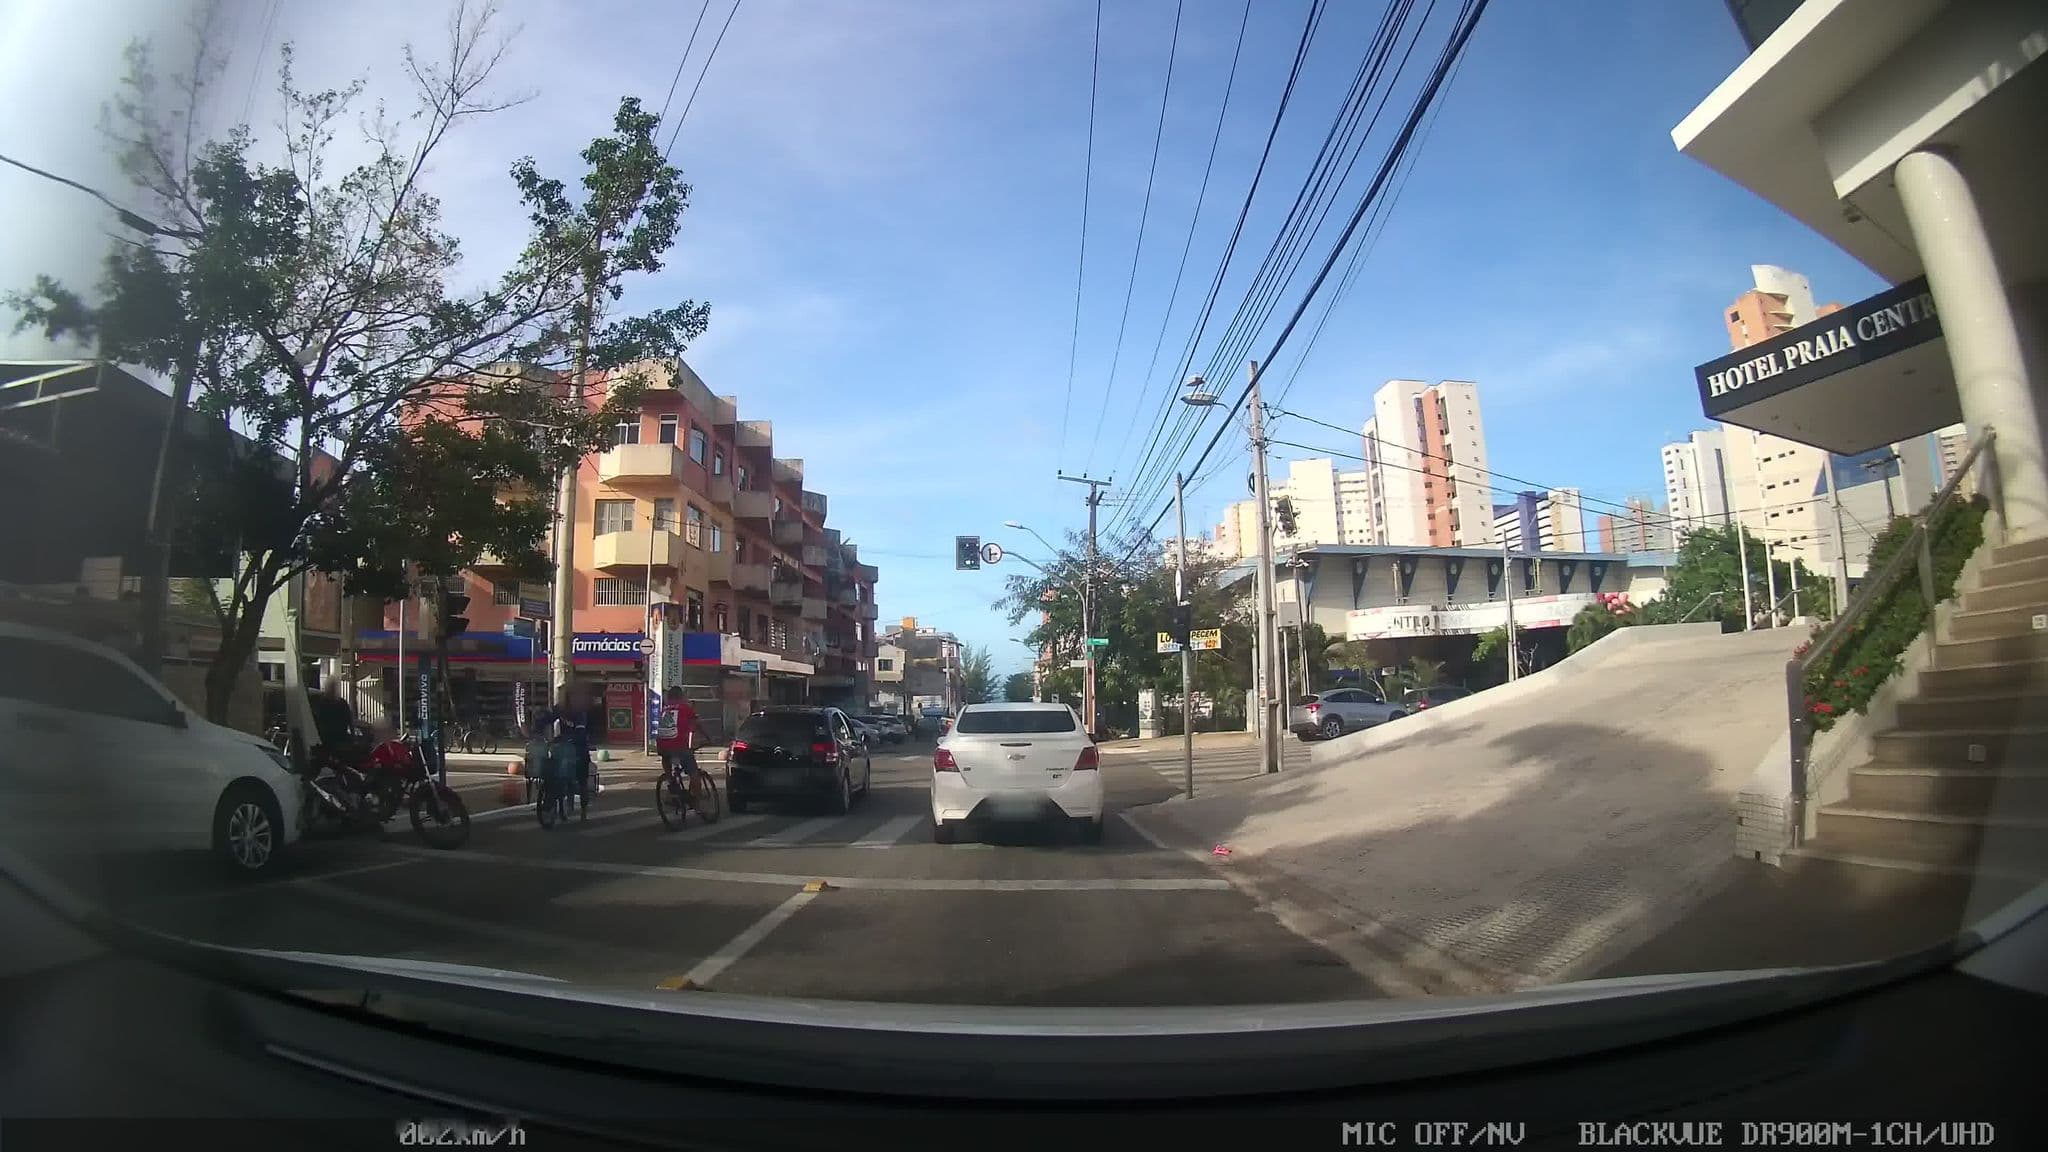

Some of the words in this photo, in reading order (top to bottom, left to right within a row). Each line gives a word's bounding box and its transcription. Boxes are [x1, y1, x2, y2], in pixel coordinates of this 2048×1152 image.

[1708, 353, 1783, 398] HOTEL
[1782, 326, 1856, 371] PRAIA
[1857, 292, 1938, 341] CENTR
[572, 638, 631, 653] farmácias
